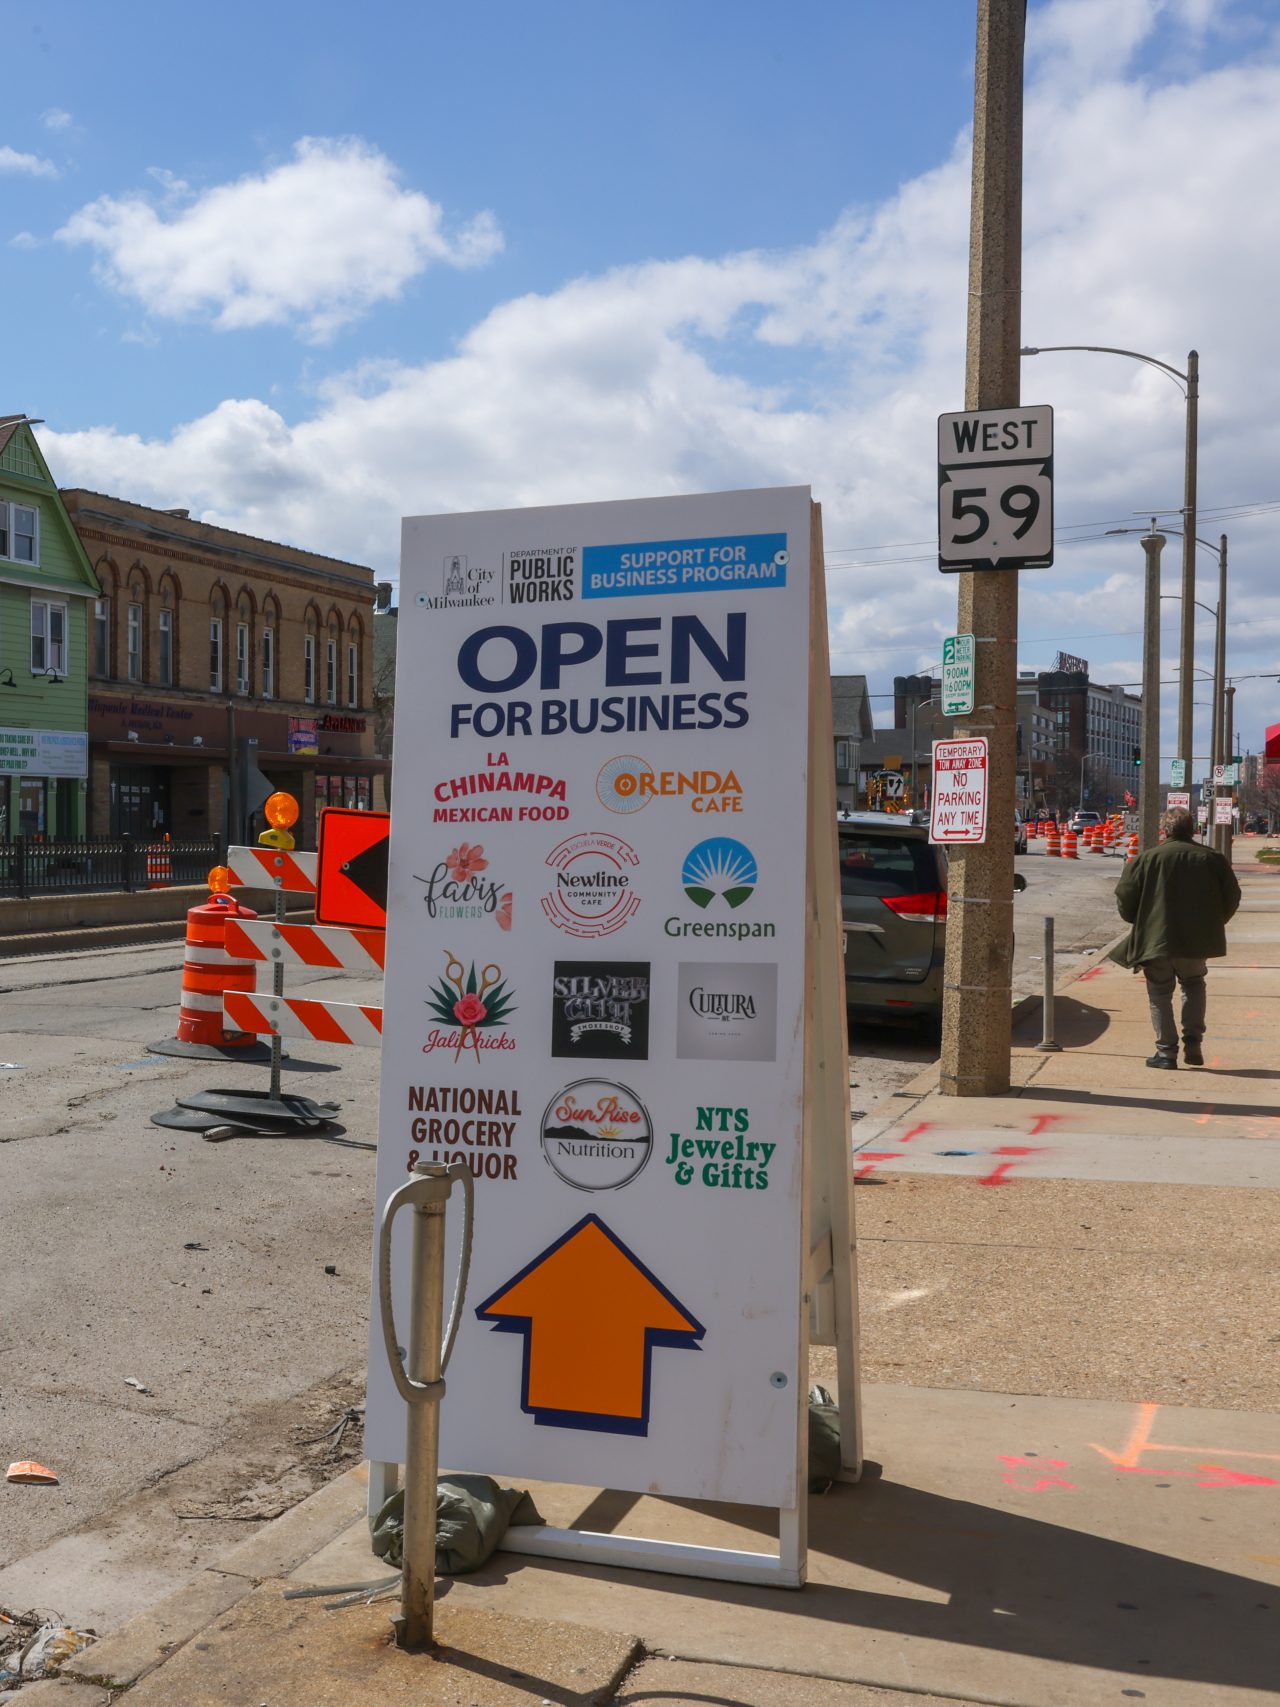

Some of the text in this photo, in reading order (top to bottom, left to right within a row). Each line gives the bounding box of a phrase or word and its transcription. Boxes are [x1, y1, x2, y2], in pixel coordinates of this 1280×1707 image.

[952, 419, 1038, 454] WEST
[951, 484, 1041, 545] 59
[510, 546, 578, 558] DEPARTMENT OF
[620, 546, 746, 569] SUPPORT FOR
[467, 568, 495, 583] City
[510, 556, 574, 581] PUBLIC
[590, 562, 777, 590] BUSINESS PROGRAM
[467, 581, 482, 594] of
[509, 579, 574, 604] WORKS
[425, 594, 495, 610] Milwaukee
[457, 612, 747, 693] OPEN
[945, 645, 954, 664] 2
[450, 691, 750, 738] FOR BUSINESS
[487, 752, 509, 767] LA
[939, 746, 983, 758] TEMPORARY
[939, 758, 982, 770] TOW AWAY ZONE
[433, 771, 567, 803] CHINAMPA
[614, 769, 744, 797] ORENDA
[953, 772, 968, 787] NO
[692, 796, 744, 813] CAFE
[938, 790, 981, 806] PARKING
[433, 806, 570, 823] MEXICAN FOOD
[938, 810, 980, 826] ANY TIME
[596, 840, 615, 850] VERDE
[556, 870, 629, 888] Newline
[440, 905, 483, 918] FLOWERS
[664, 917, 776, 941] Greenspan
[688, 987, 757, 1019] CULTURA
[578, 1022, 625, 1032] SMOKE SHOP
[408, 1086, 522, 1116] NATIONAL
[695, 1106, 750, 1133] NTS
[411, 1117, 516, 1148] GROCERY
[556, 1141, 635, 1160] Nutrition
[665, 1132, 777, 1170] Jewelry
[407, 1150, 420, 1173] &
[674, 1162, 770, 1190] & Gifts
